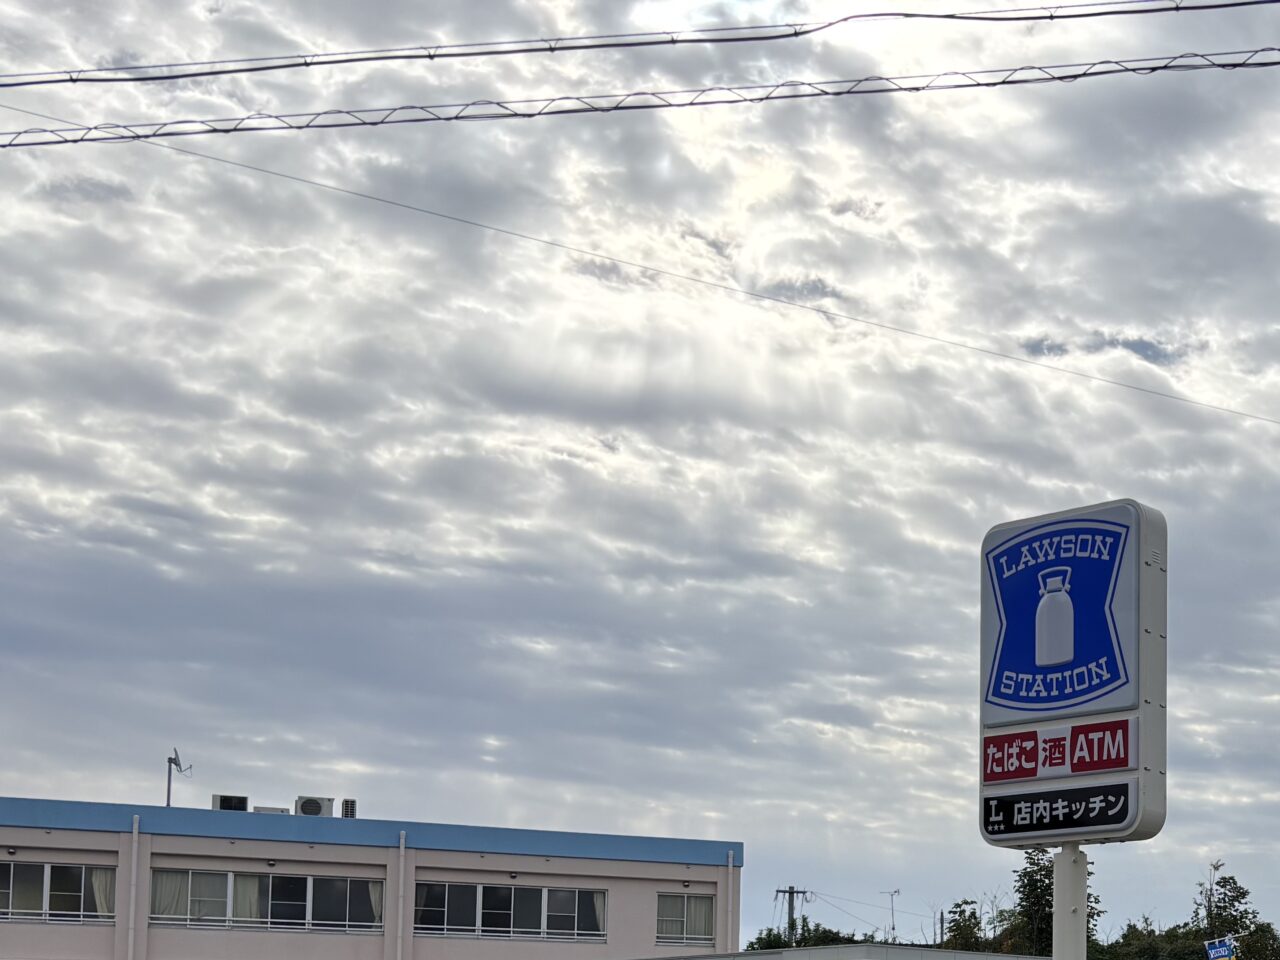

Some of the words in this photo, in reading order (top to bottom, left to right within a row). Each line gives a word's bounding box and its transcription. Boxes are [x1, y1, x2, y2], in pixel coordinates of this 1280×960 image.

[1000, 534, 1114, 579] LAWSON
[1000, 656, 1111, 697] STATION
[986, 739, 1036, 774] たばこ
[1041, 736, 1067, 768] 酒
[1072, 729, 1125, 764] ATM
[1013, 795, 1125, 826] 店内キッチン
